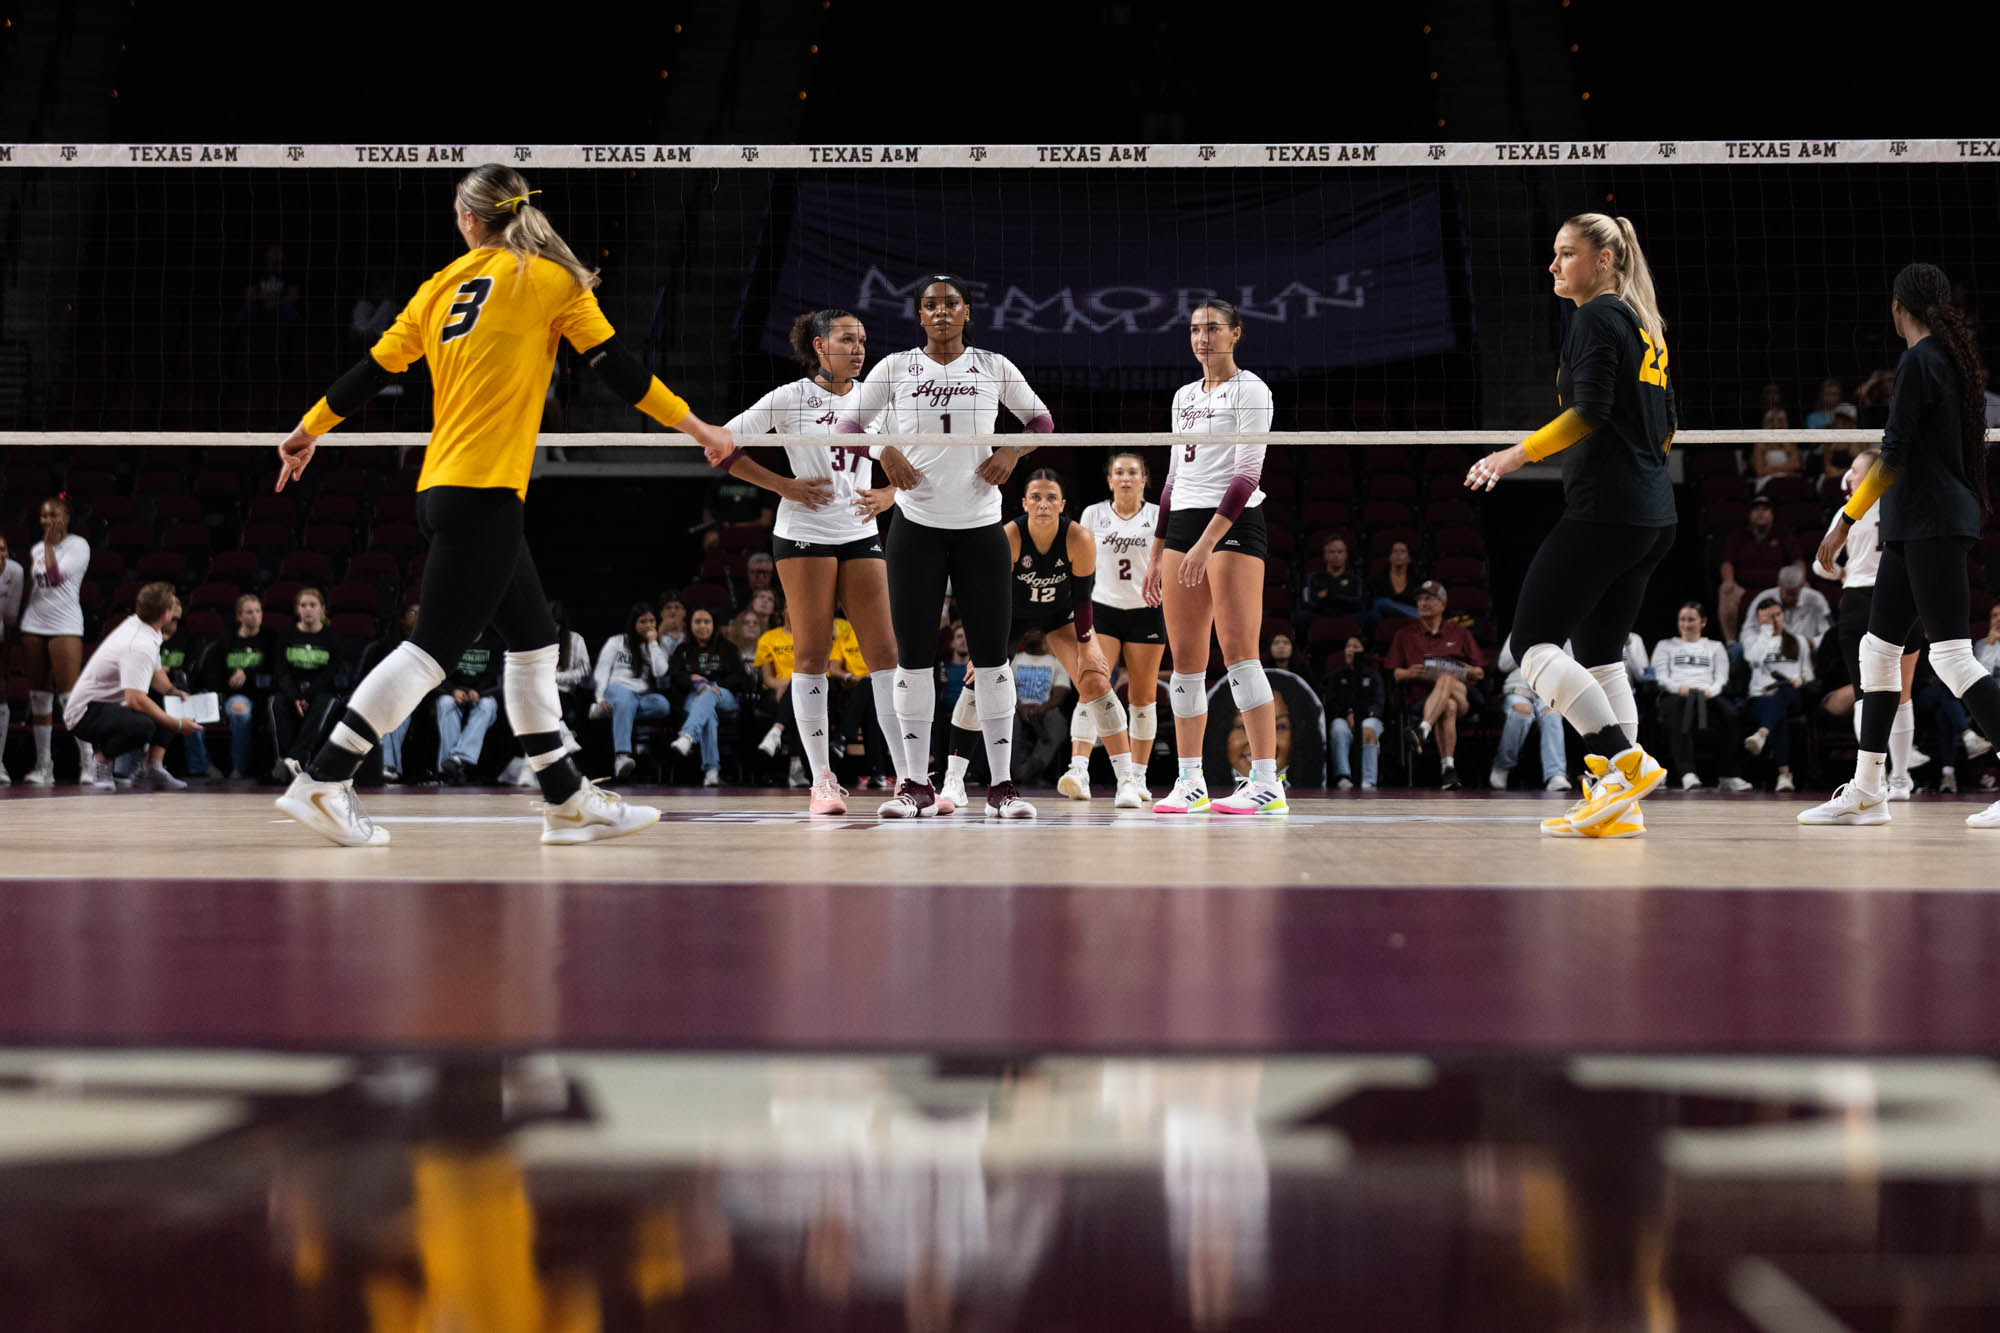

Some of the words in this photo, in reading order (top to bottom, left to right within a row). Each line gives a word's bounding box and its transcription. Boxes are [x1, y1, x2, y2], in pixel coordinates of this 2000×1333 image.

[129, 146, 192, 162] TEXAS
[200, 146, 237, 162] A&M
[356, 146, 418, 162] TEXAS
[426, 146, 464, 162] A&M
[582, 146, 645, 162] TEXAS
[653, 146, 692, 162] A&M
[809, 146, 872, 162] TEXAS
[881, 146, 919, 162] A&M
[1037, 146, 1100, 162] TEXAS
[1109, 146, 1147, 162] A&M
[1266, 145, 1329, 161] TEXAS
[1337, 145, 1377, 161] A&M
[1496, 143, 1559, 160] TEXAS
[1568, 143, 1606, 160] A&M
[1726, 142, 1790, 158] TEXAS
[1798, 142, 1837, 158] A&M
[1957, 140, 2000, 156] TEX
[441, 276, 494, 344] 3
[911, 379, 979, 407] Aggies
[940, 413, 951, 434] 1
[831, 446, 863, 473] 37
[1102, 531, 1147, 553] Aggies
[1118, 558, 1132, 581] 2
[1017, 571, 1068, 588] Aggies
[1029, 587, 1056, 603] 12
